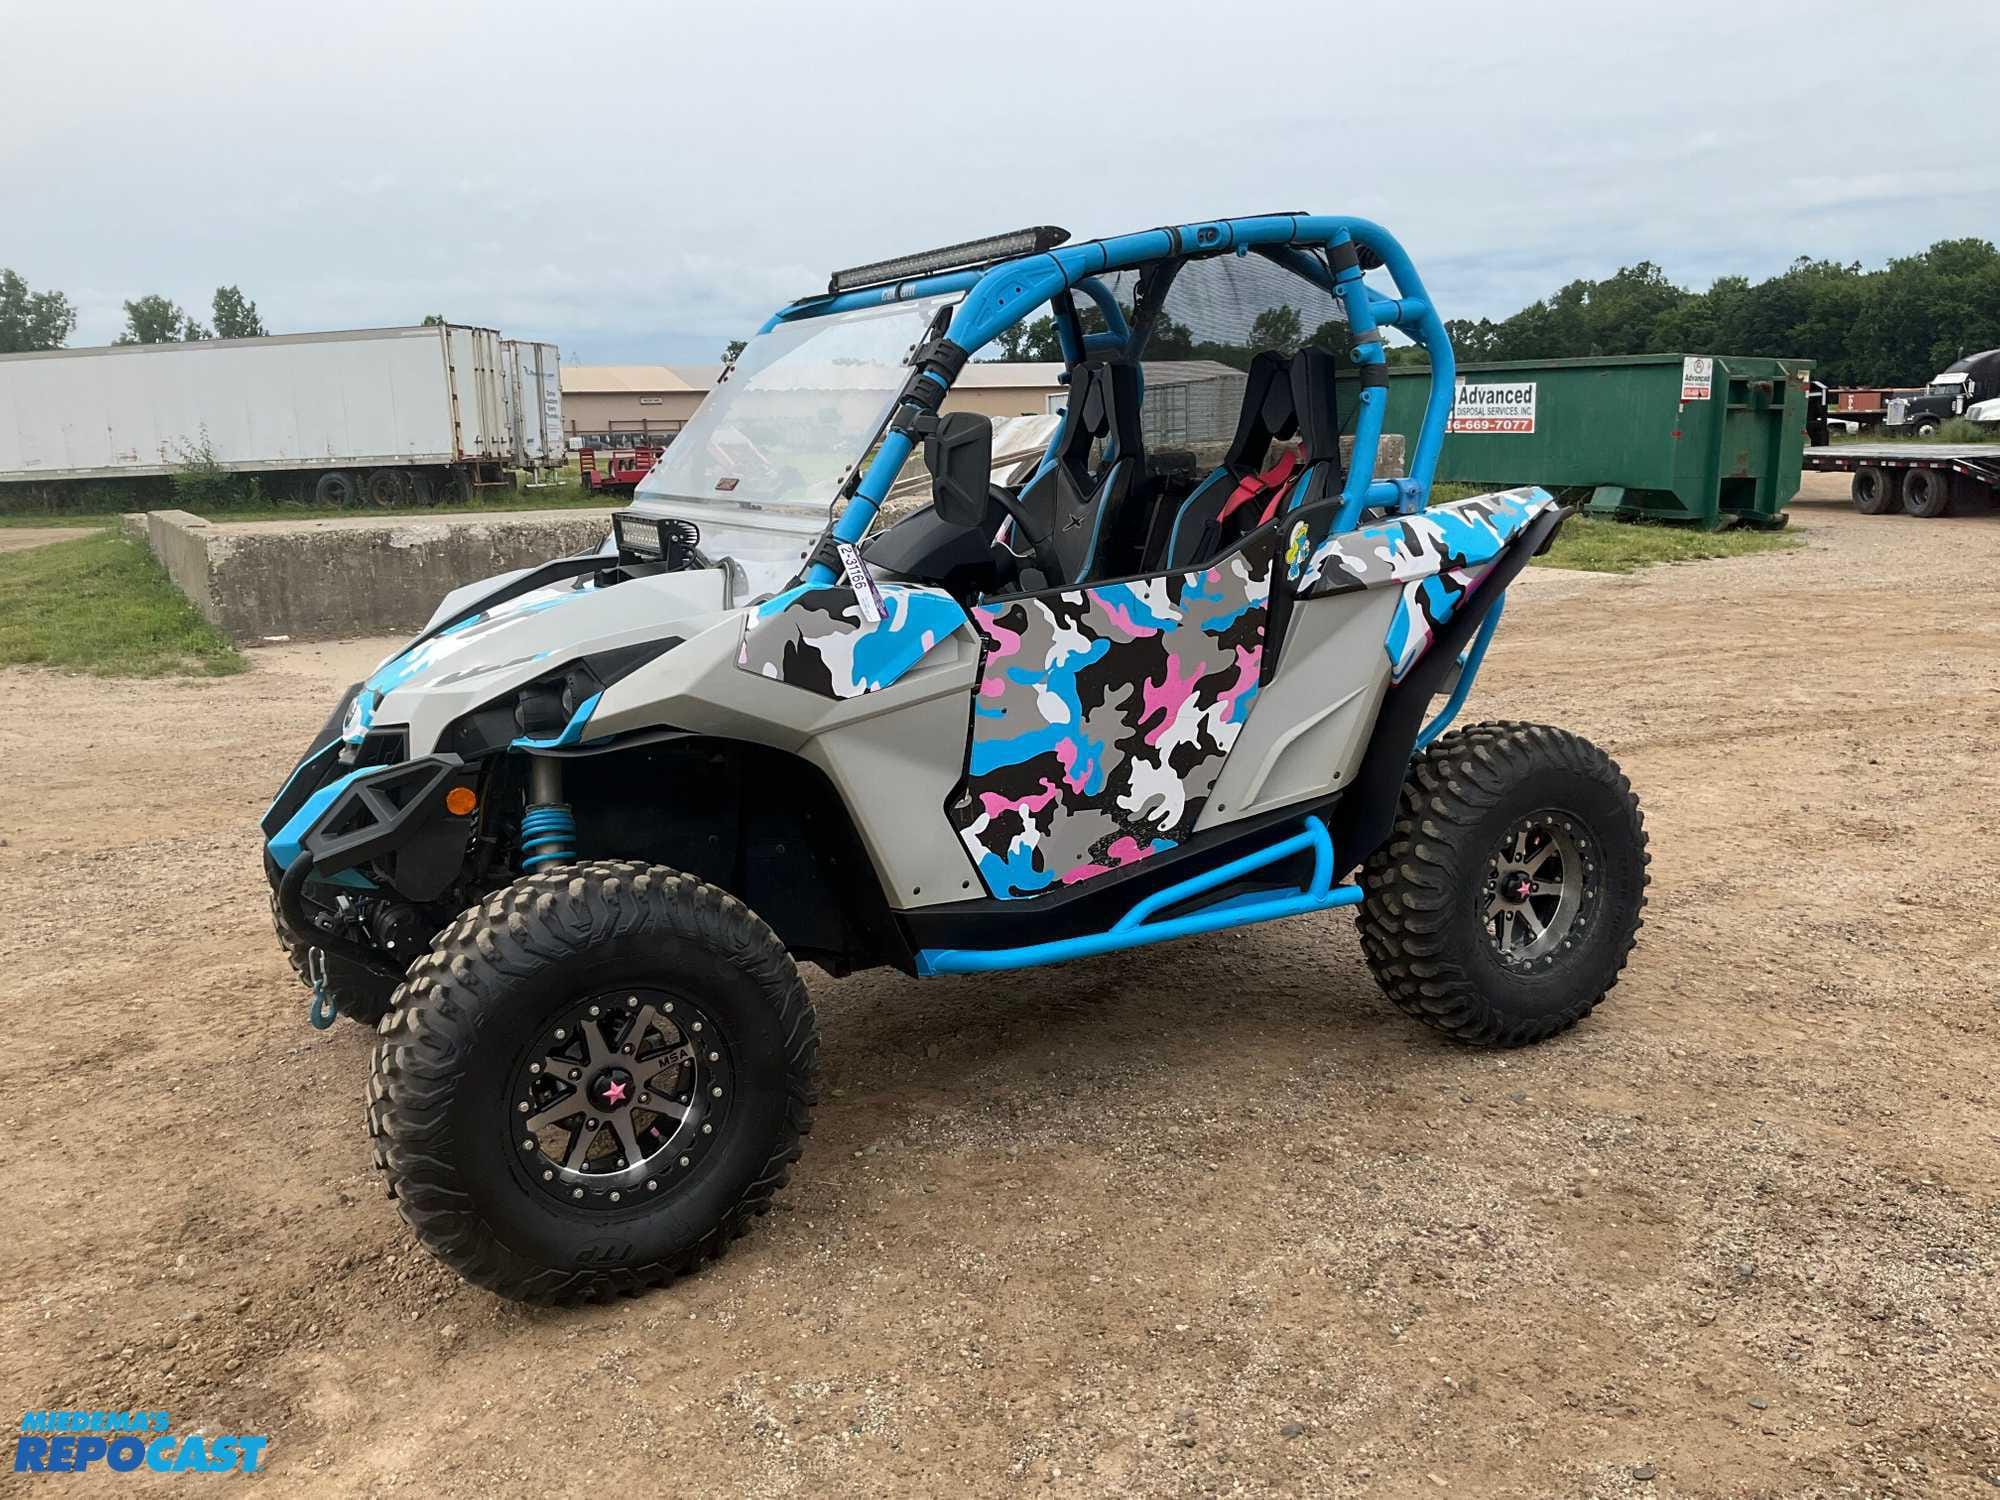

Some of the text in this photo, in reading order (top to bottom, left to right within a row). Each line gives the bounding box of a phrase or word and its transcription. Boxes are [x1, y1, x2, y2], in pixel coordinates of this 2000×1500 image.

[1458, 385, 1532, 404] Advanced
[1457, 407, 1485, 416] DISPOSAL
[1447, 420, 1529, 430] 16-669-7077
[840, 546, 867, 590] 2-31166
[658, 1049, 689, 1069] MSA
